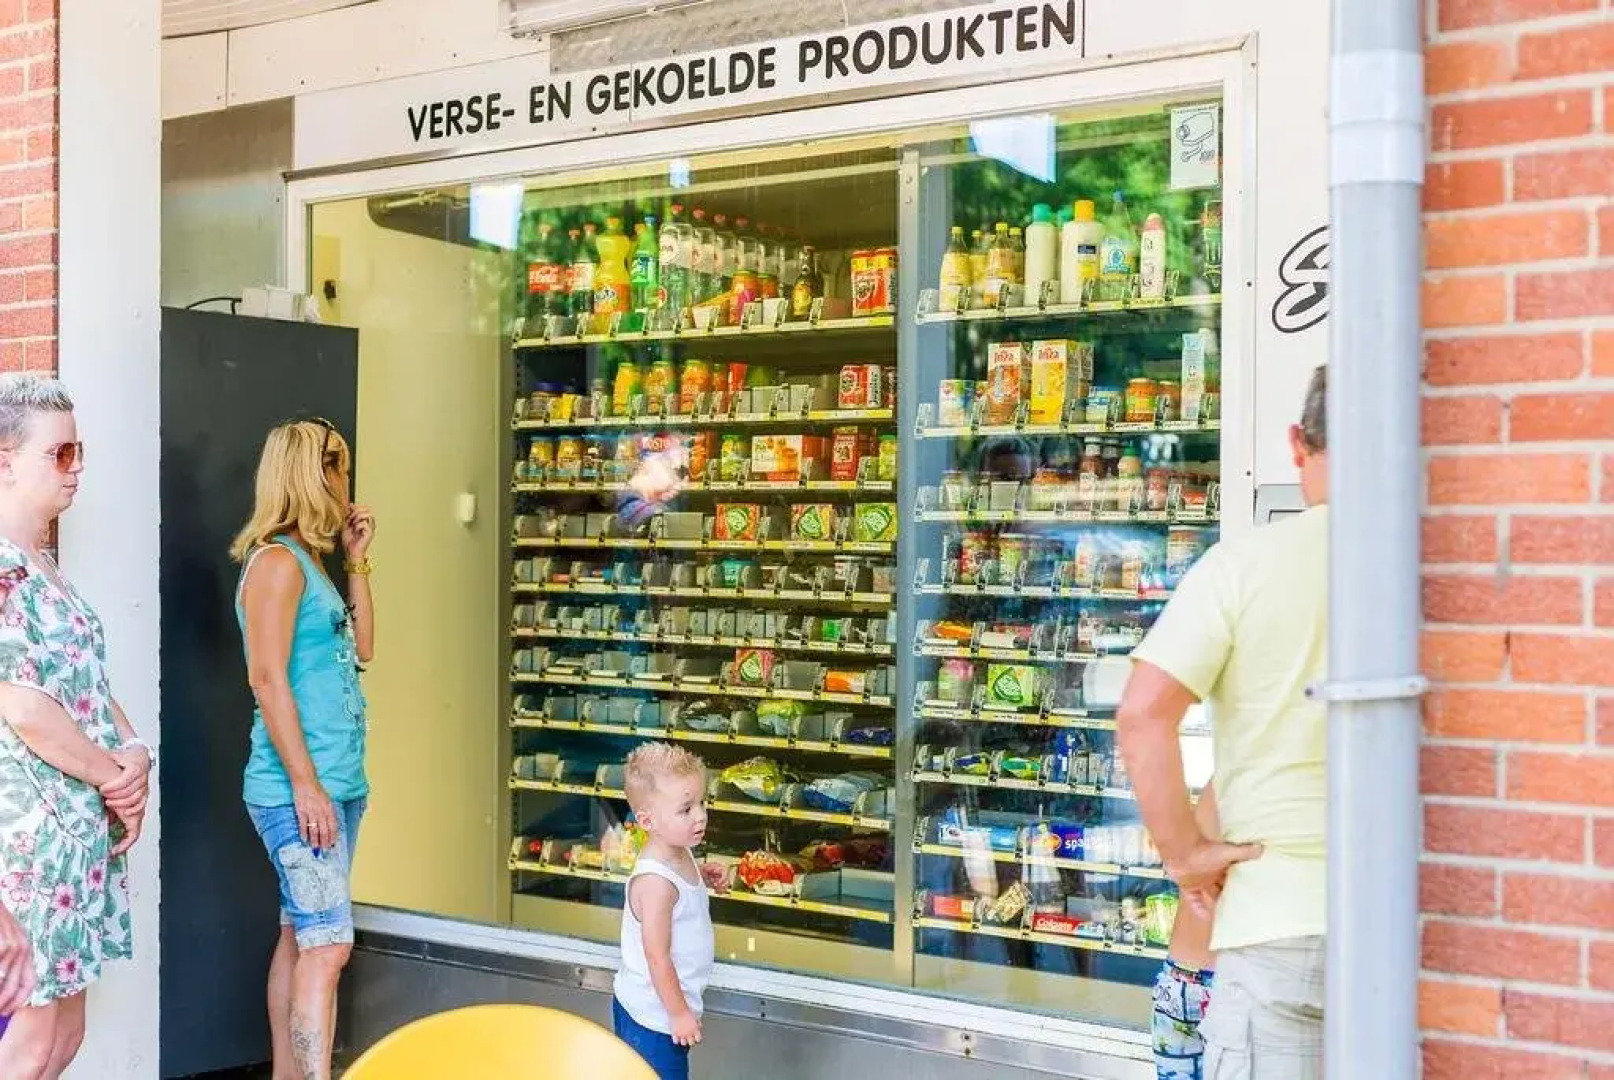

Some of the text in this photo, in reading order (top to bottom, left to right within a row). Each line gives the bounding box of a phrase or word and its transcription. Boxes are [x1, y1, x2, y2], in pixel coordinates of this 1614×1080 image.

[407, 0, 1075, 142] VERSE- EN GEKOELDE PRODUKTEN
